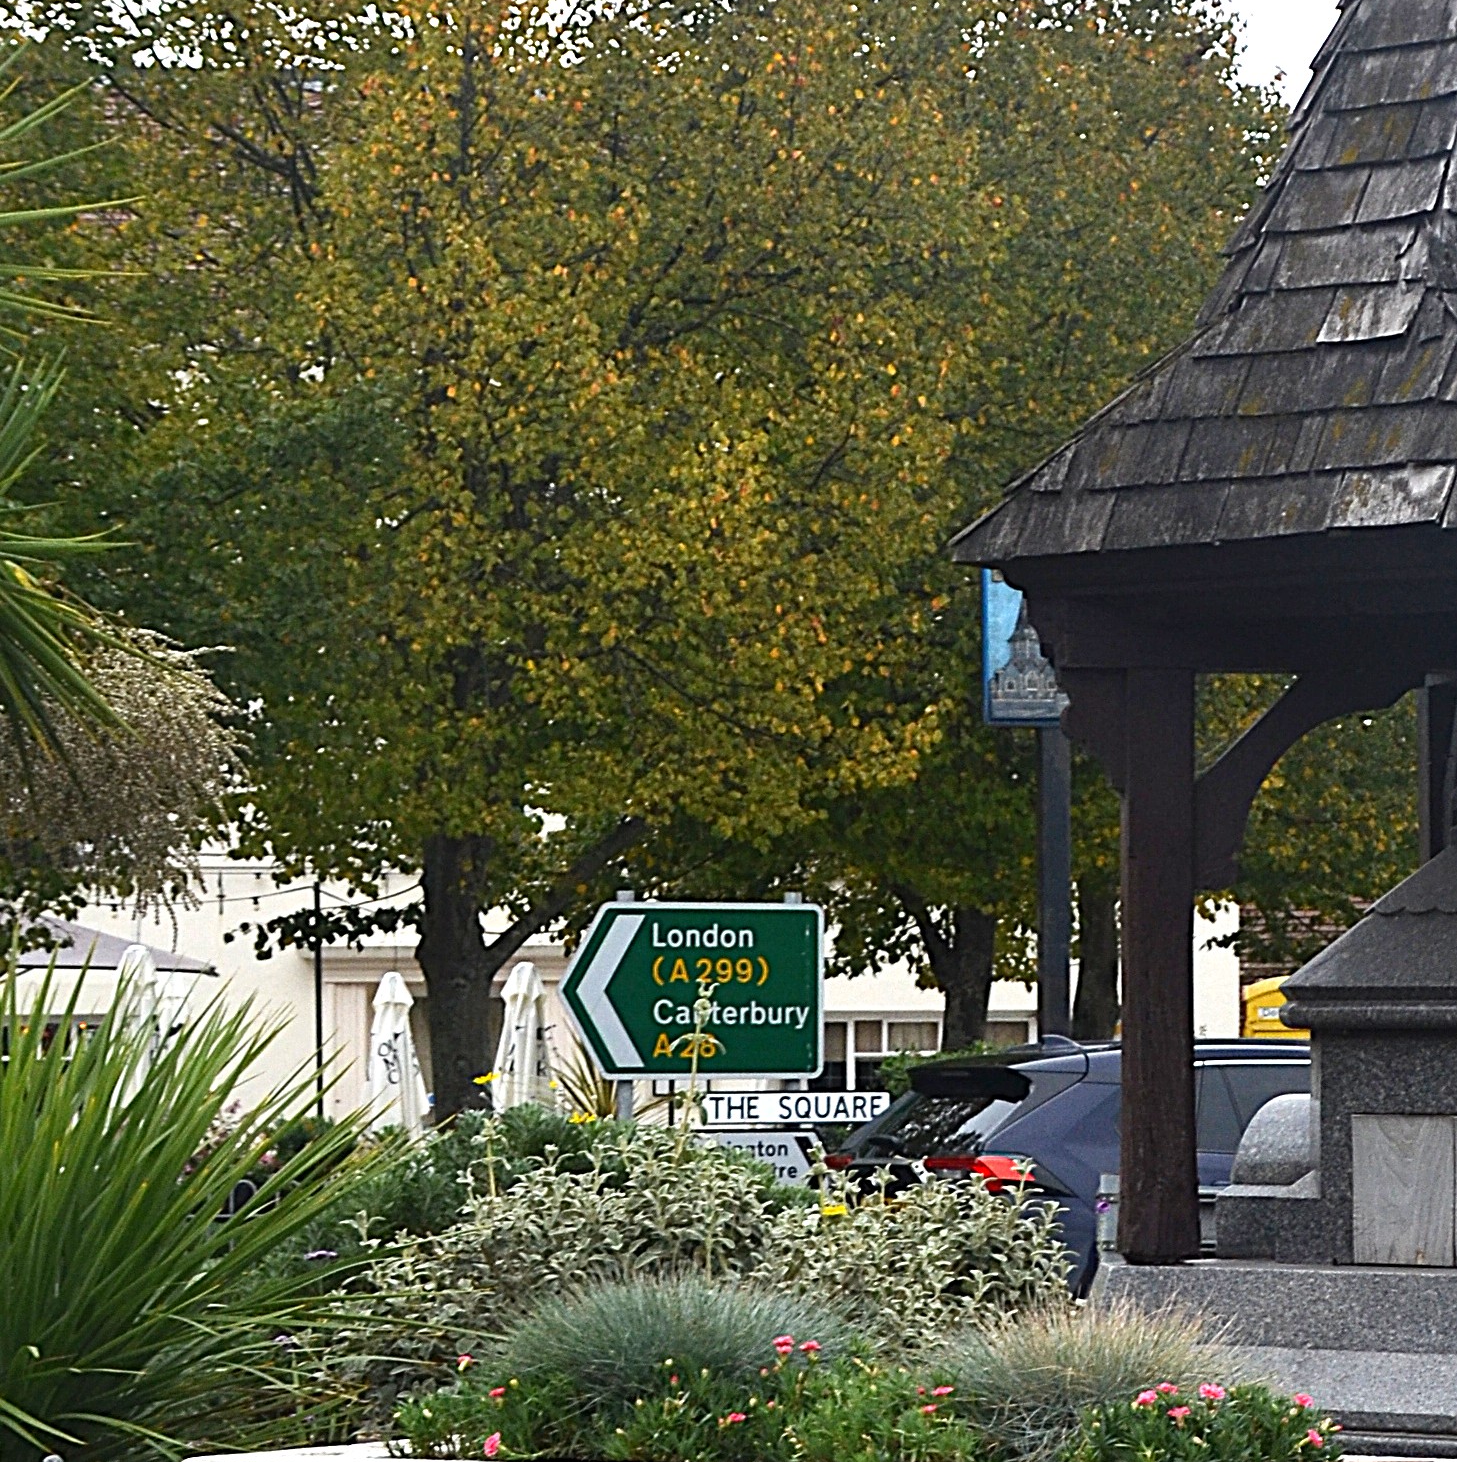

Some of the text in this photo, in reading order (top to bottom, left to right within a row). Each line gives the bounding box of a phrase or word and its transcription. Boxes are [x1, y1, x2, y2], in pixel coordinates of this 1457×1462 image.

[652, 922, 754, 948] London
[652, 955, 770, 986] (A299)
[709, 1095, 883, 1120] THE SQUARE
